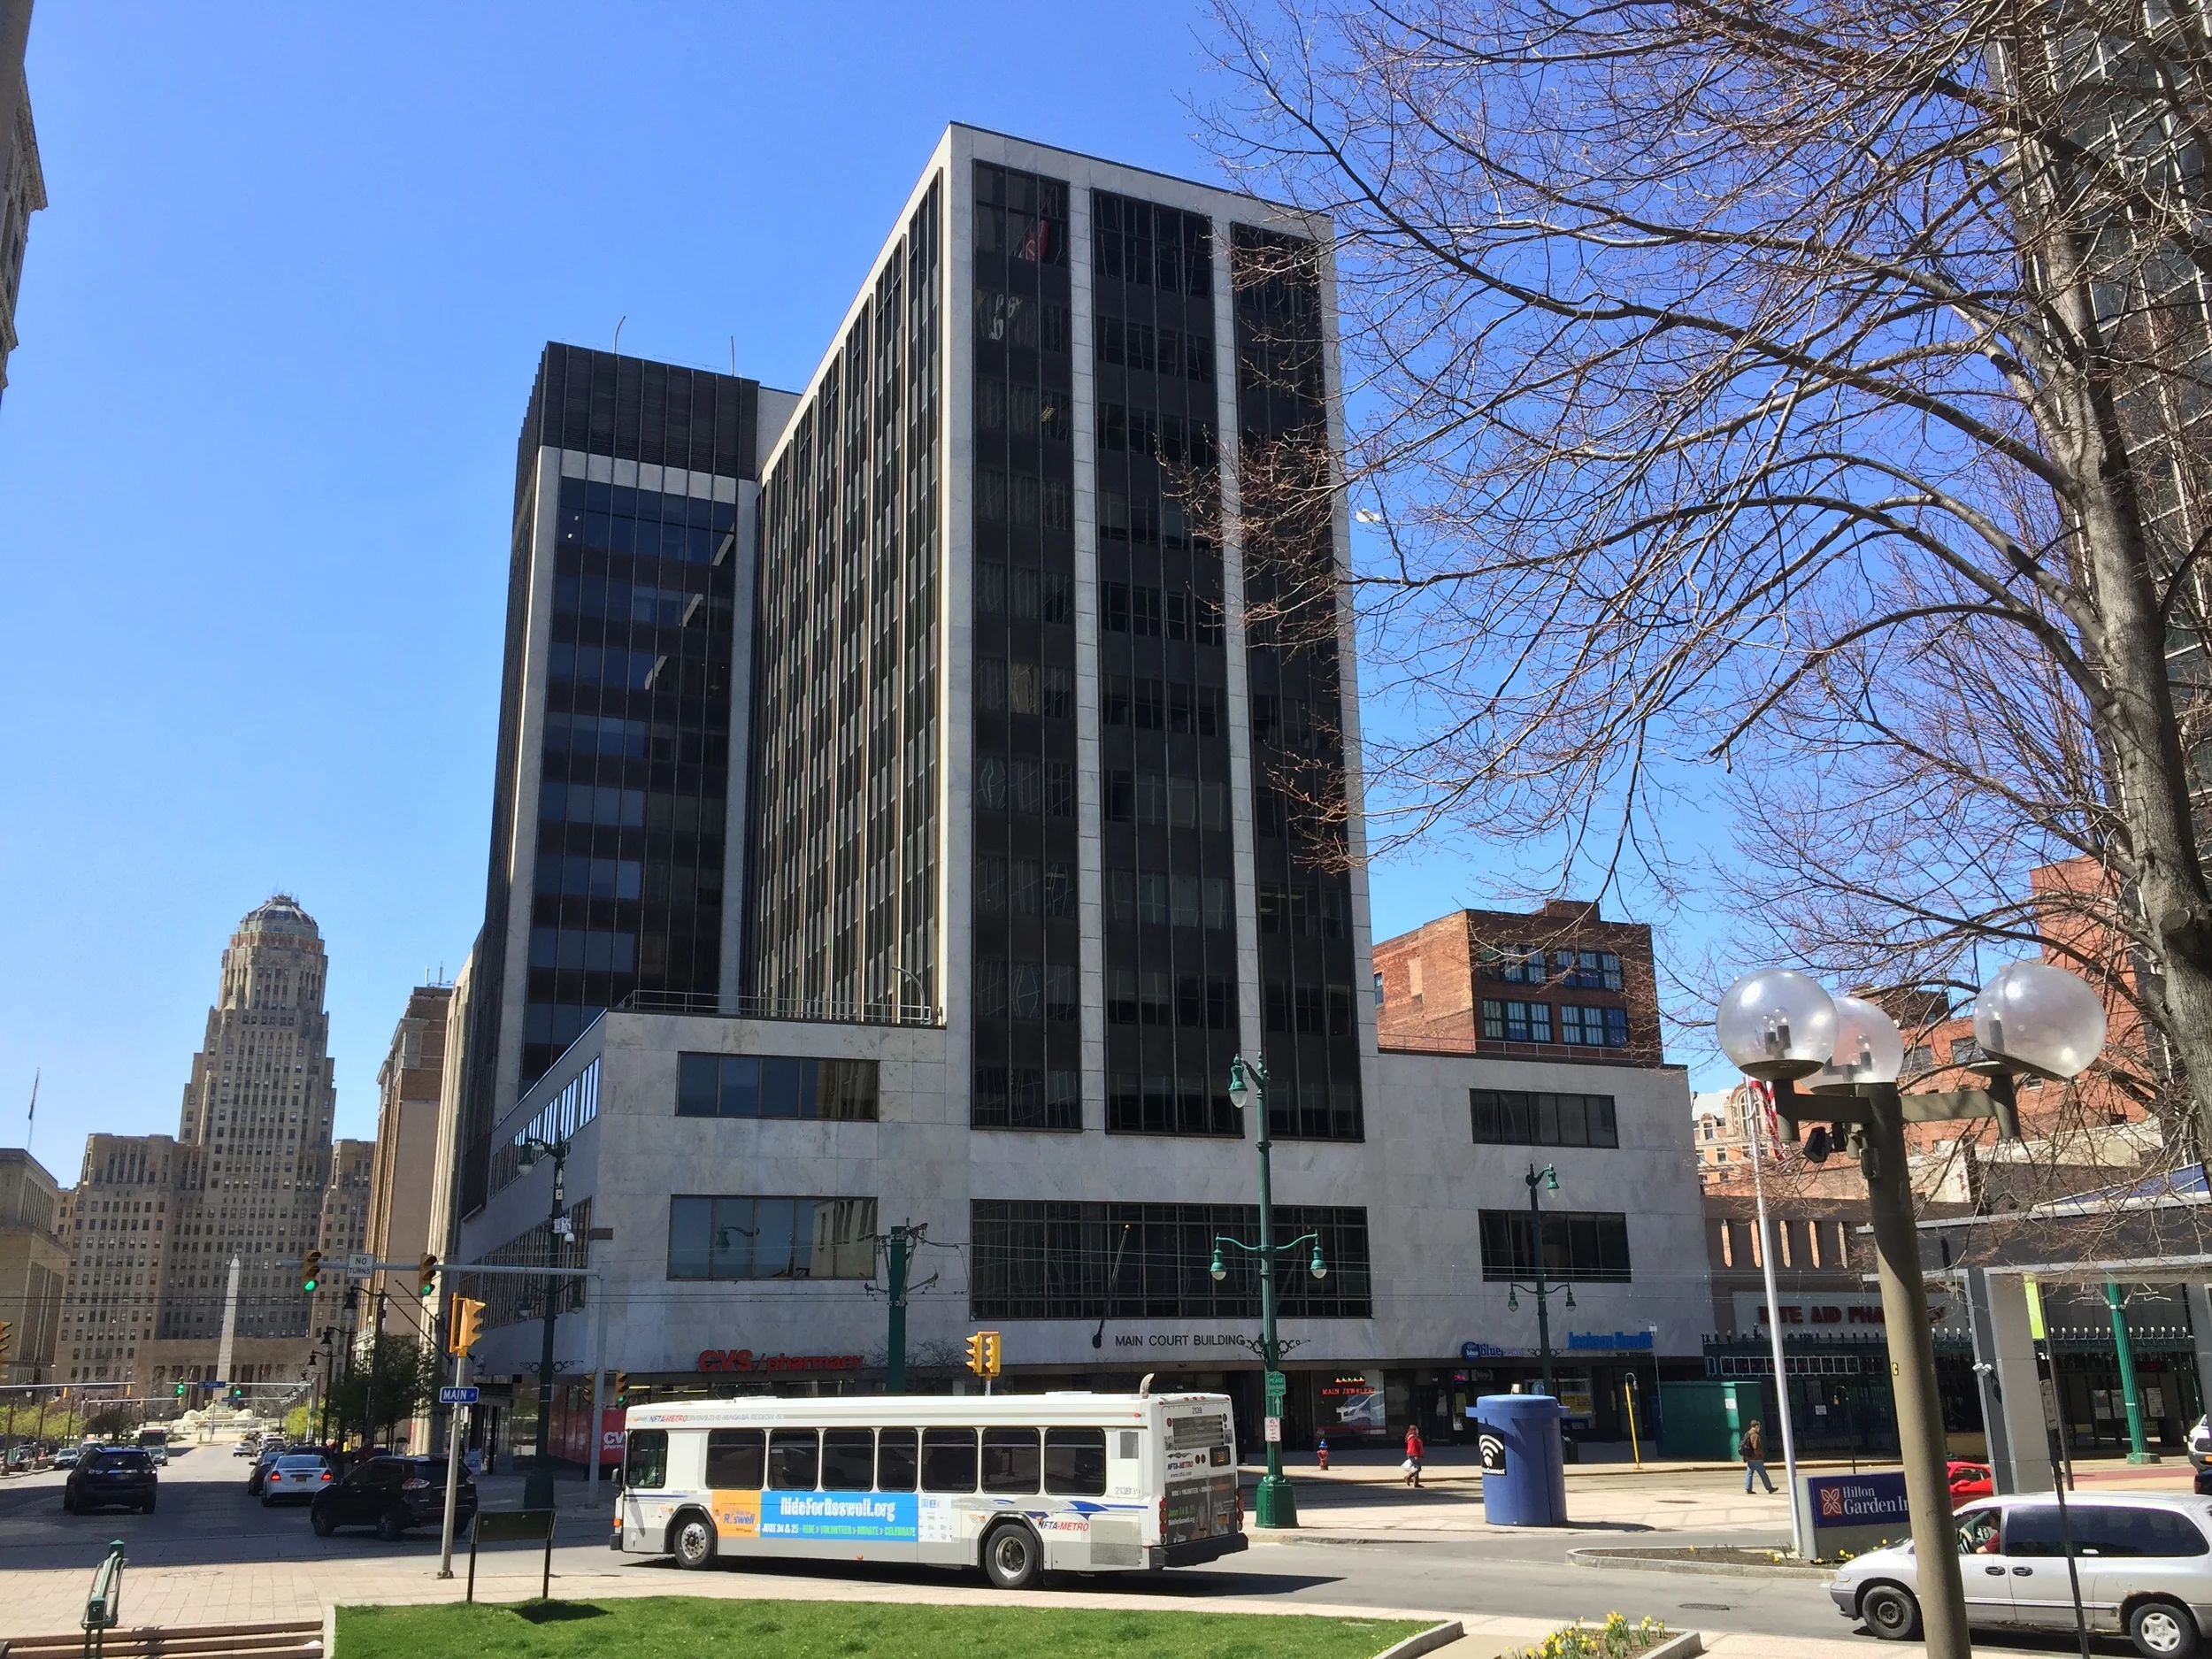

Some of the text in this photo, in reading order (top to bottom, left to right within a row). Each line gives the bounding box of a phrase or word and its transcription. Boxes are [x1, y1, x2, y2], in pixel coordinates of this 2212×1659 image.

[1810, 1306, 1842, 1324] AID
[1115, 1334, 1246, 1347] MAIN COURT BUILDING
[1479, 1344, 1502, 1356] blue
[443, 1389, 467, 1400] MAIN
[1843, 1486, 1876, 1498] Hilton
[1844, 1497, 1896, 1515] Garden
[1038, 1520, 1089, 1532] NFTA-METRO
